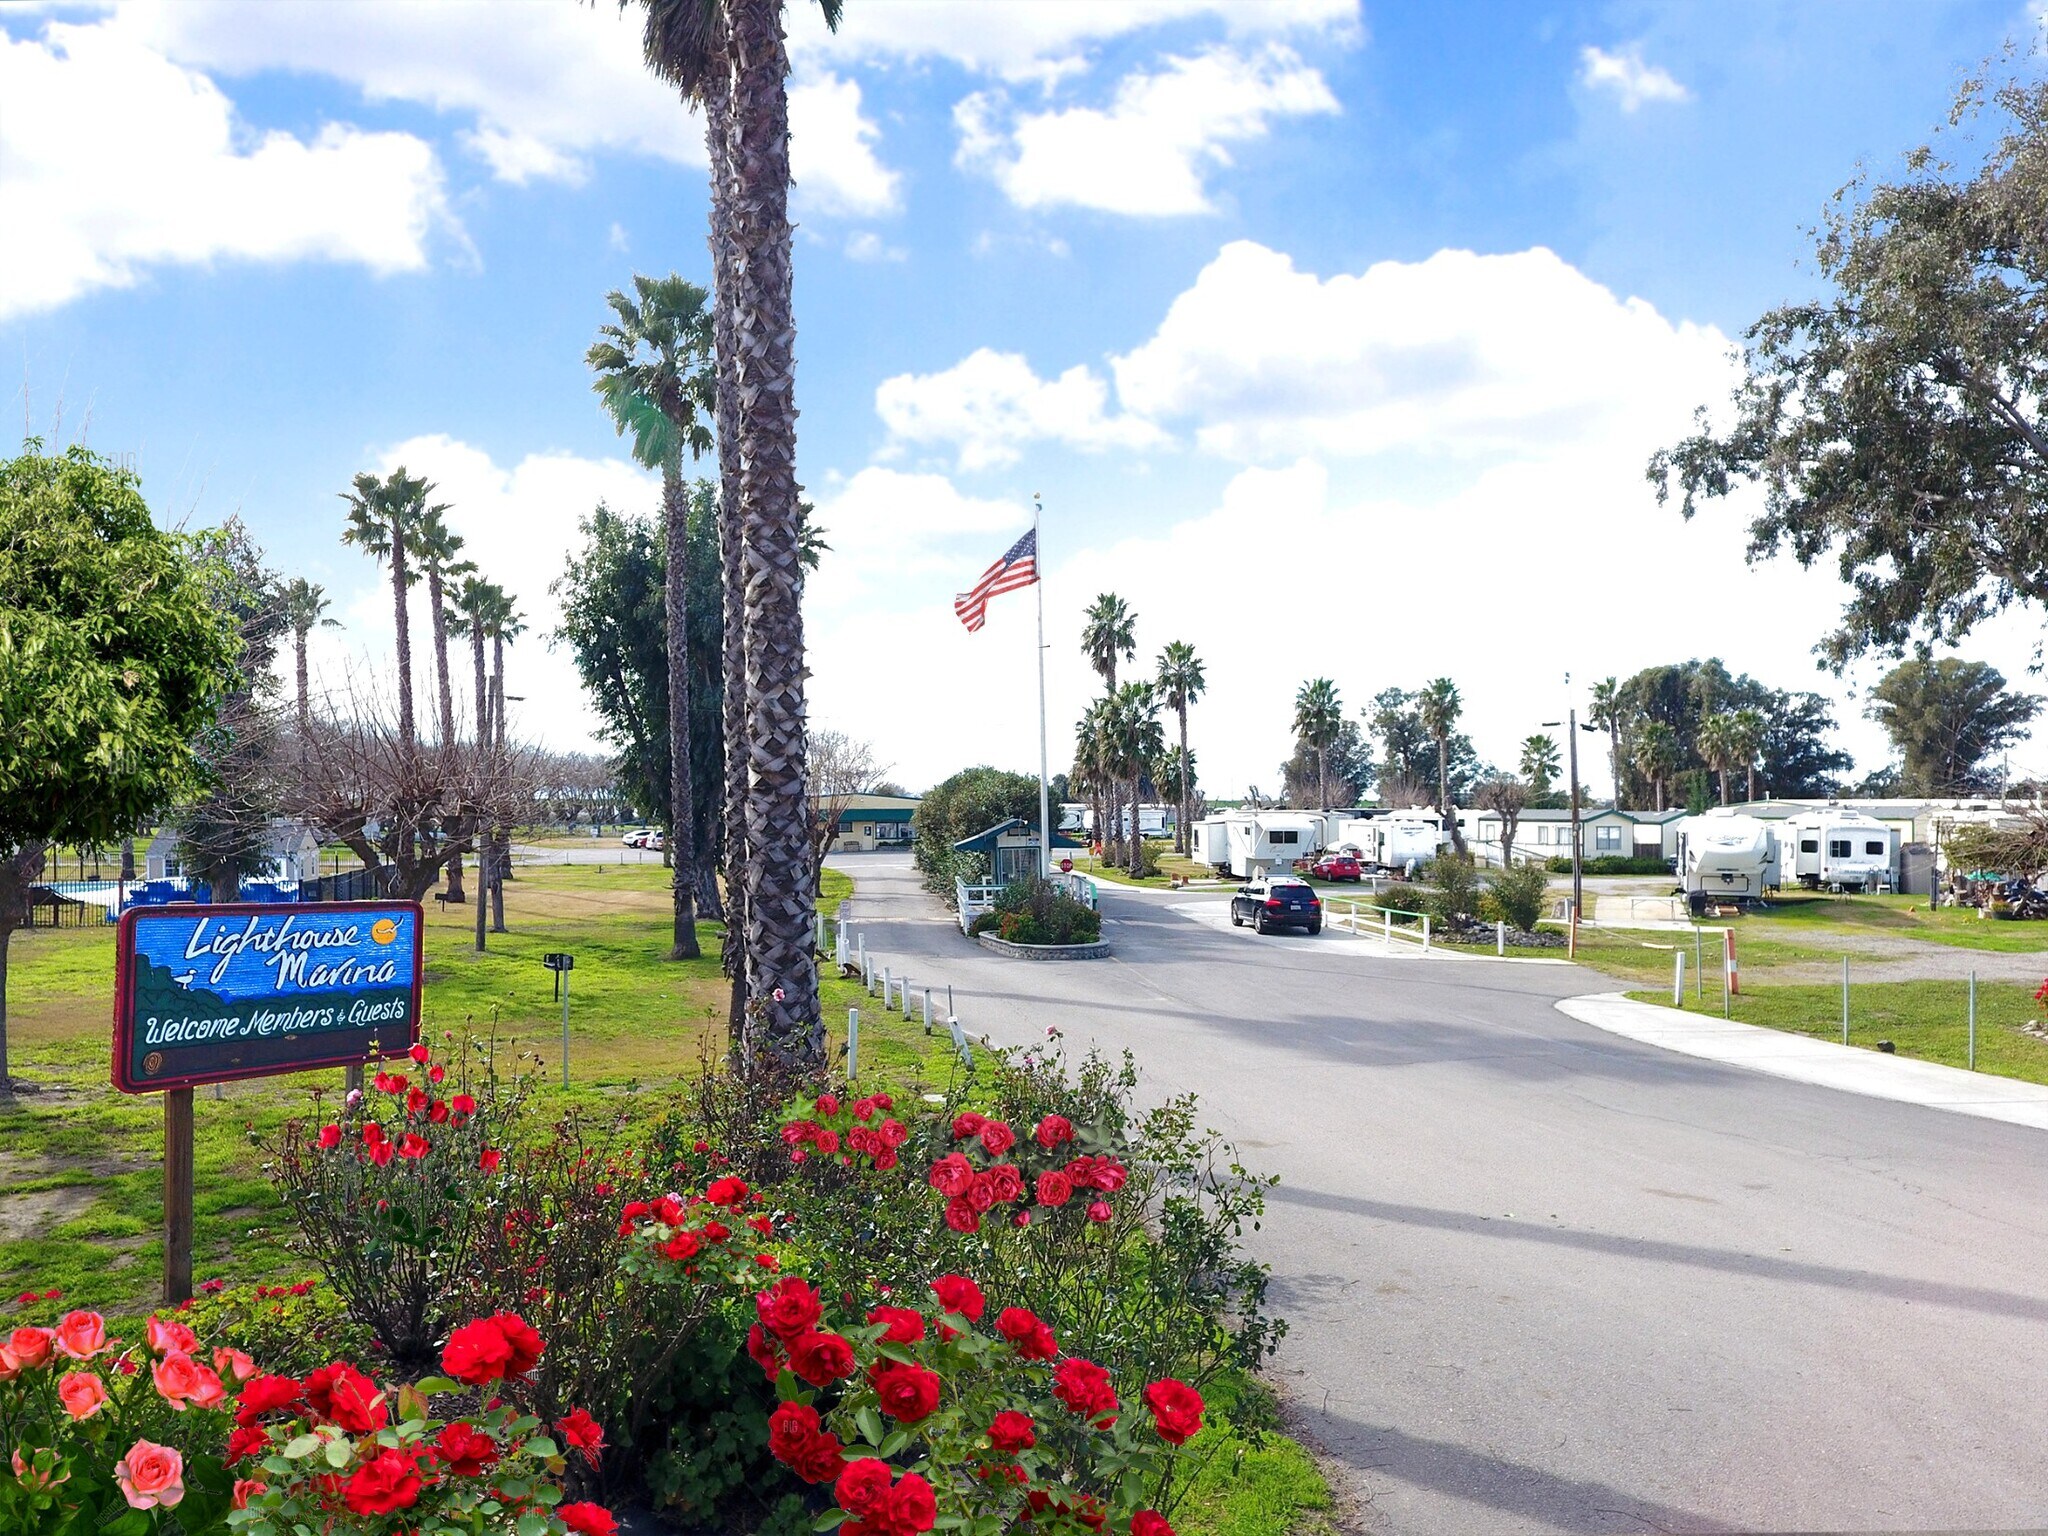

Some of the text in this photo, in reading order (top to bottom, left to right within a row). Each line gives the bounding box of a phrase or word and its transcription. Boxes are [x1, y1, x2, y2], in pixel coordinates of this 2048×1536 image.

[184, 915, 362, 984] Lighthouse
[264, 950, 396, 990] Marina
[145, 997, 405, 1044] Welcome Members & Guests
